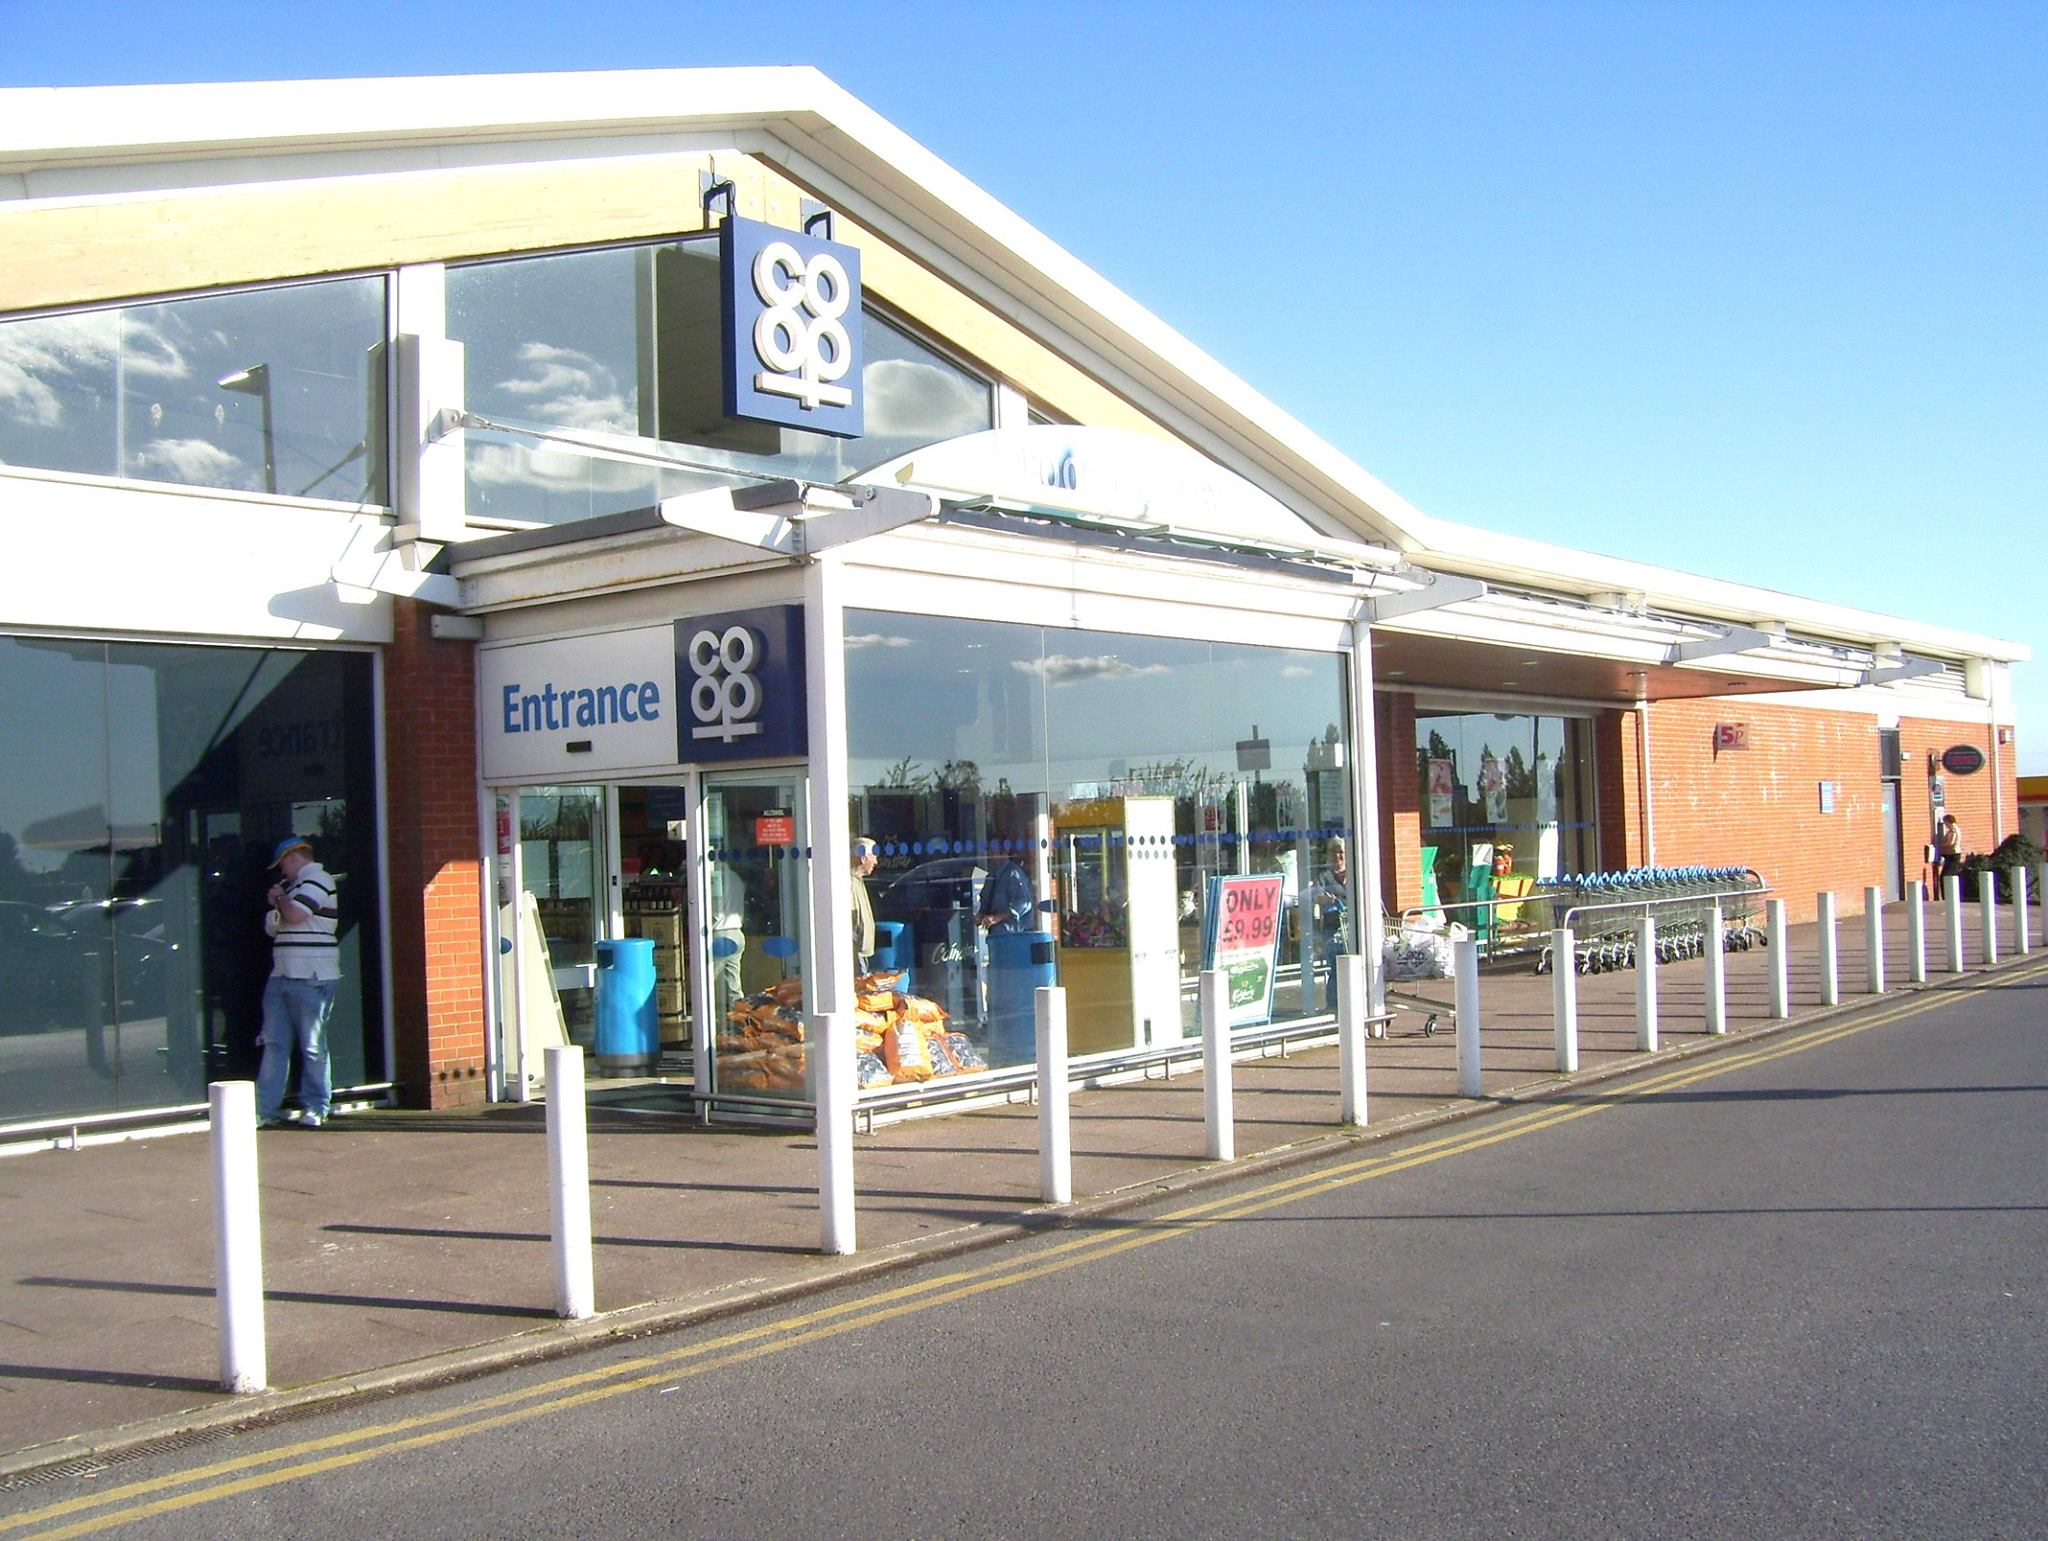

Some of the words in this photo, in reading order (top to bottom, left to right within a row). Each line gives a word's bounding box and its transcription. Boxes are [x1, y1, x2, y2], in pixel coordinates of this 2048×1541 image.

[502, 681, 660, 733] Entrance
[1227, 887, 1275, 913] ONLY
[1223, 917, 1273, 942] £9.99
